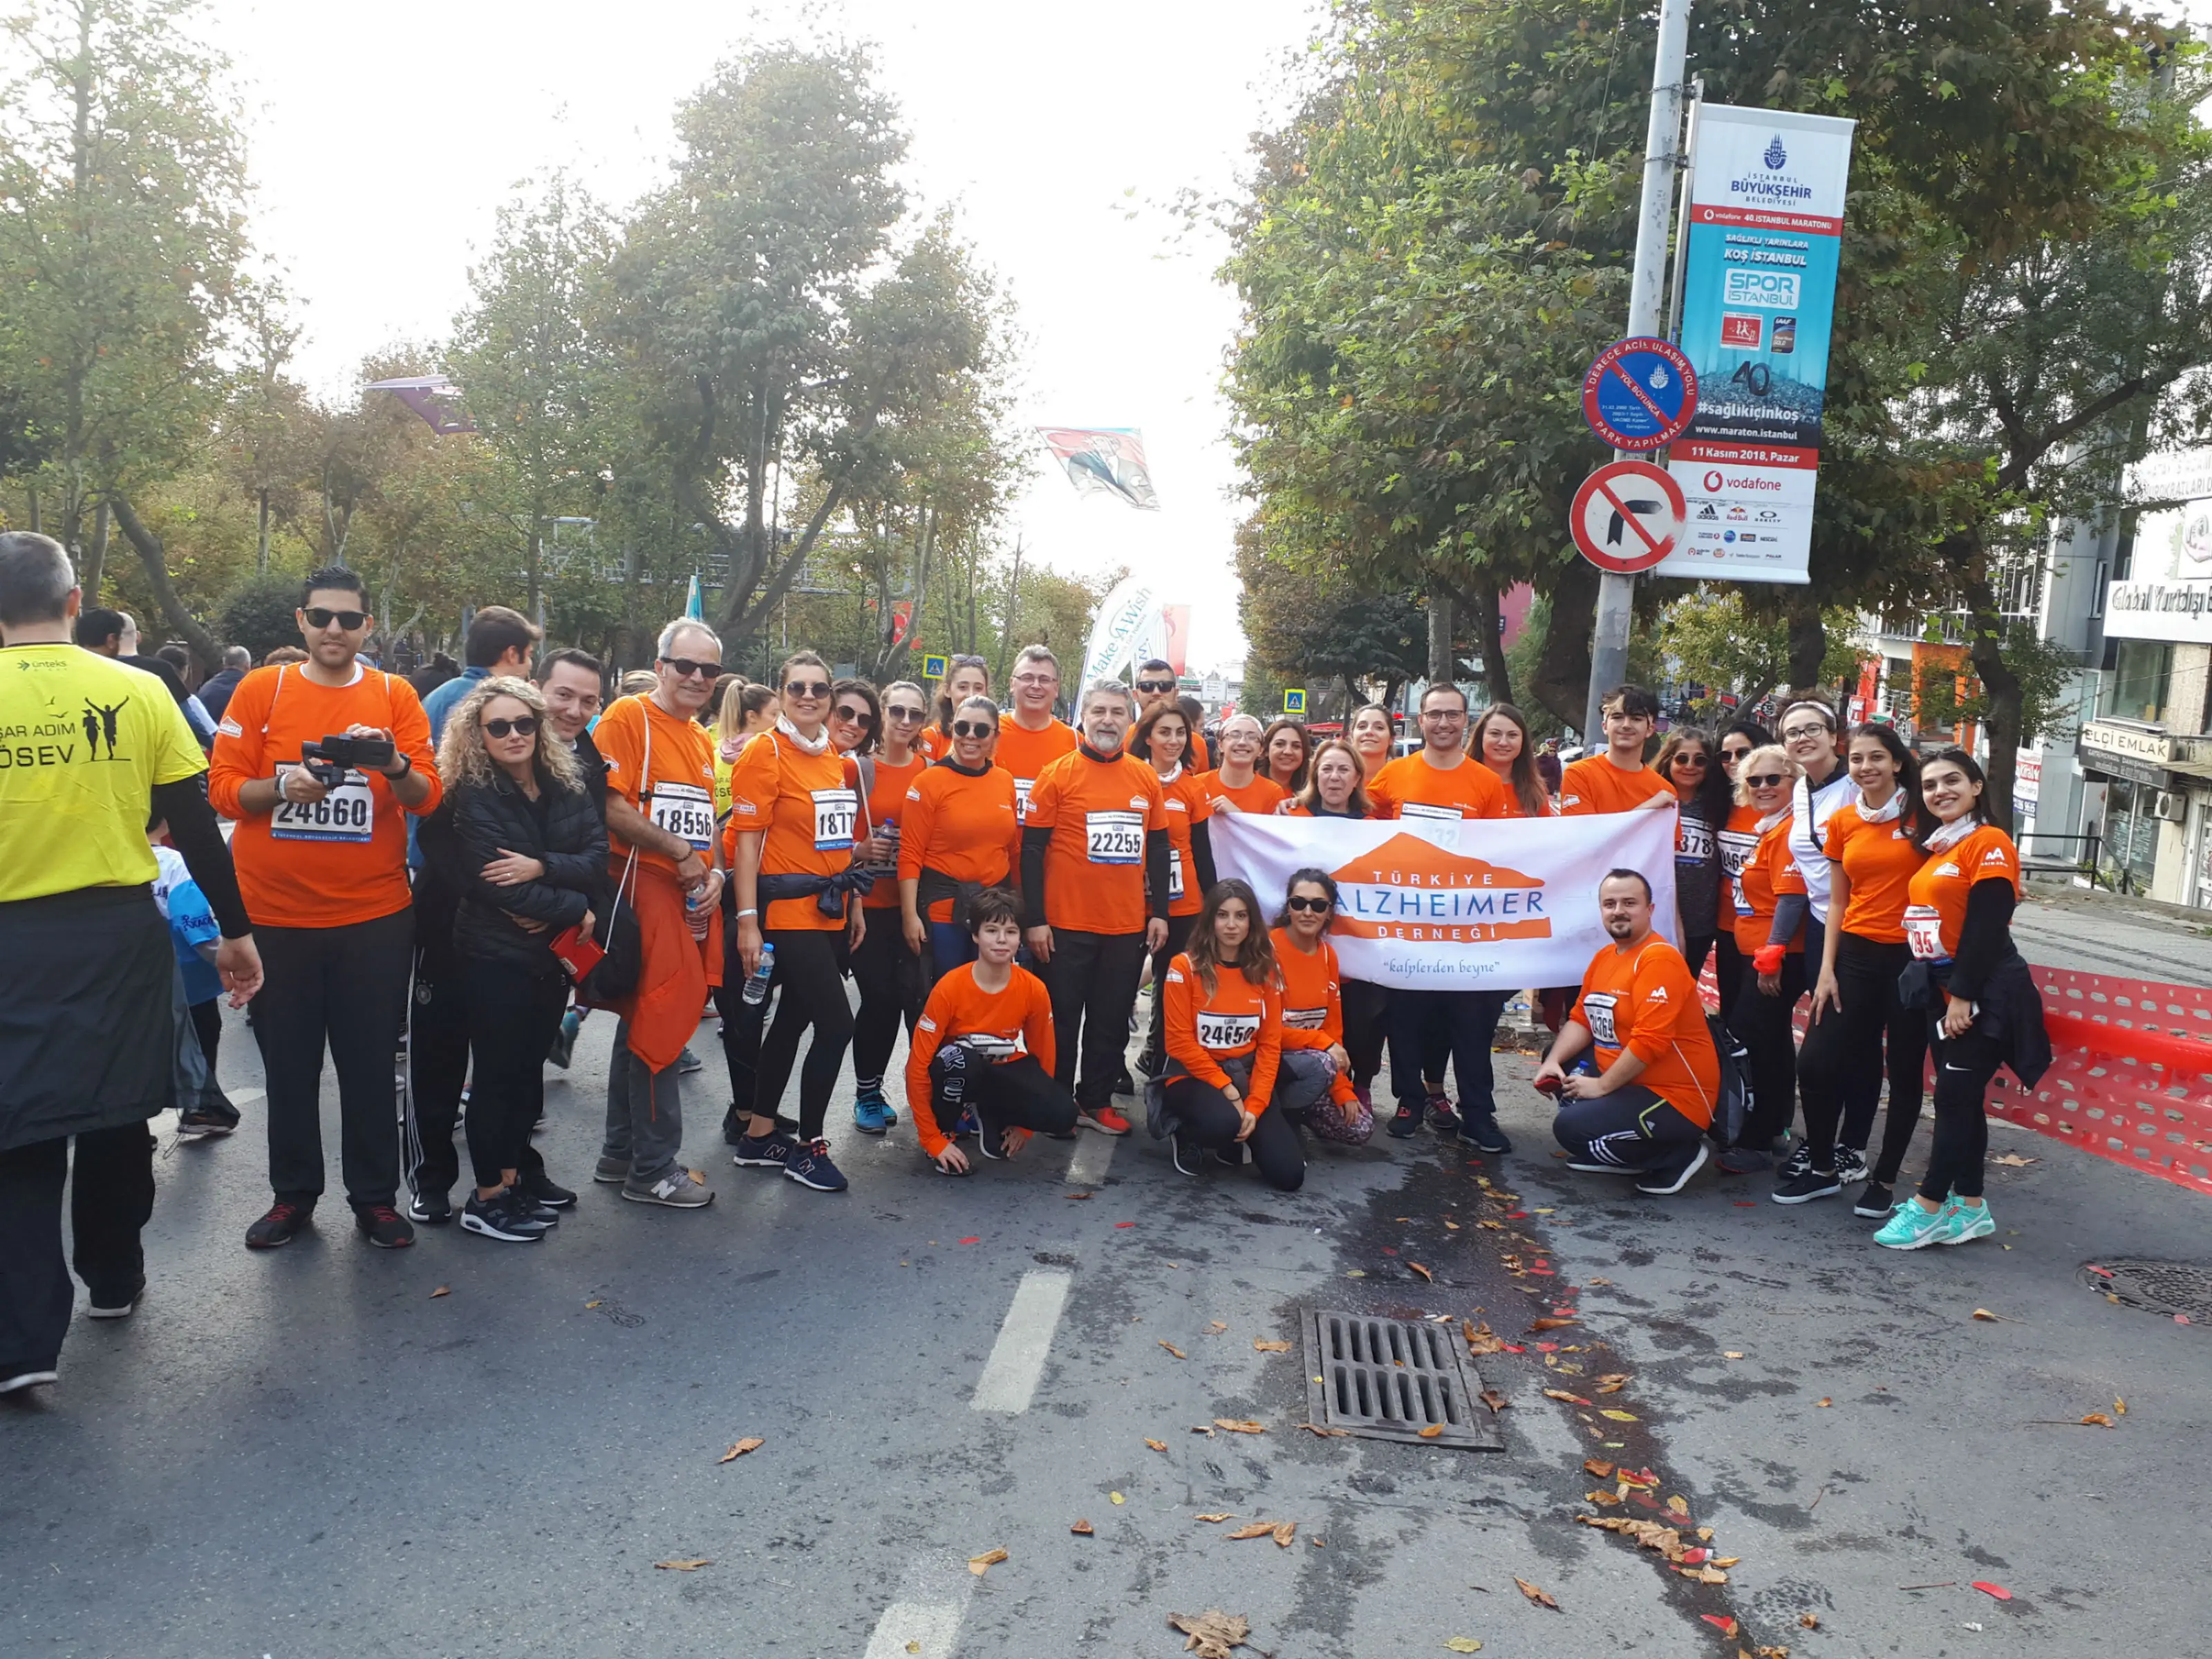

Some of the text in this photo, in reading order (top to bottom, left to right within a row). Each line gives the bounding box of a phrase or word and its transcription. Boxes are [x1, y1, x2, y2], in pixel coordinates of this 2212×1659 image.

[1747, 172, 1798, 183] İSTANBUL
[1731, 178, 1812, 200] BÜYÜKŞEHİR
[1745, 196, 1797, 206] BELEDİYESİ
[1715, 212, 1741, 221] vodafone
[1791, 218, 1832, 229] MARATONU
[1725, 234, 1808, 250] SAĞLIKLI YARINLARA
[1724, 248, 1807, 266] KOŞ İSTANBUL
[1730, 272, 1793, 294] SPOR
[1588, 348, 1622, 384] DERECE
[1683, 368, 1695, 395] YOLU
[1620, 373, 1633, 388] YOL
[1631, 386, 1662, 418] BOYUNCA
[1595, 421, 1682, 447] PARK YAPILMAZ
[1695, 425, 1798, 440] www.maraton.istanbul
[1691, 447, 1800, 463] 11 Kasım 2018, Pazar
[1727, 477, 1781, 491] vodafone
[2112, 584, 2153, 611] Global
[33, 722, 75, 737] ADIM
[2085, 728, 2166, 757] ELÇİ EMLAK
[277, 798, 366, 827] 24660
[657, 808, 712, 837] 18556
[1091, 832, 1141, 853] 22255
[1373, 870, 1492, 885] TÜRKİYE
[1378, 925, 1495, 939] DERNEĞİ
